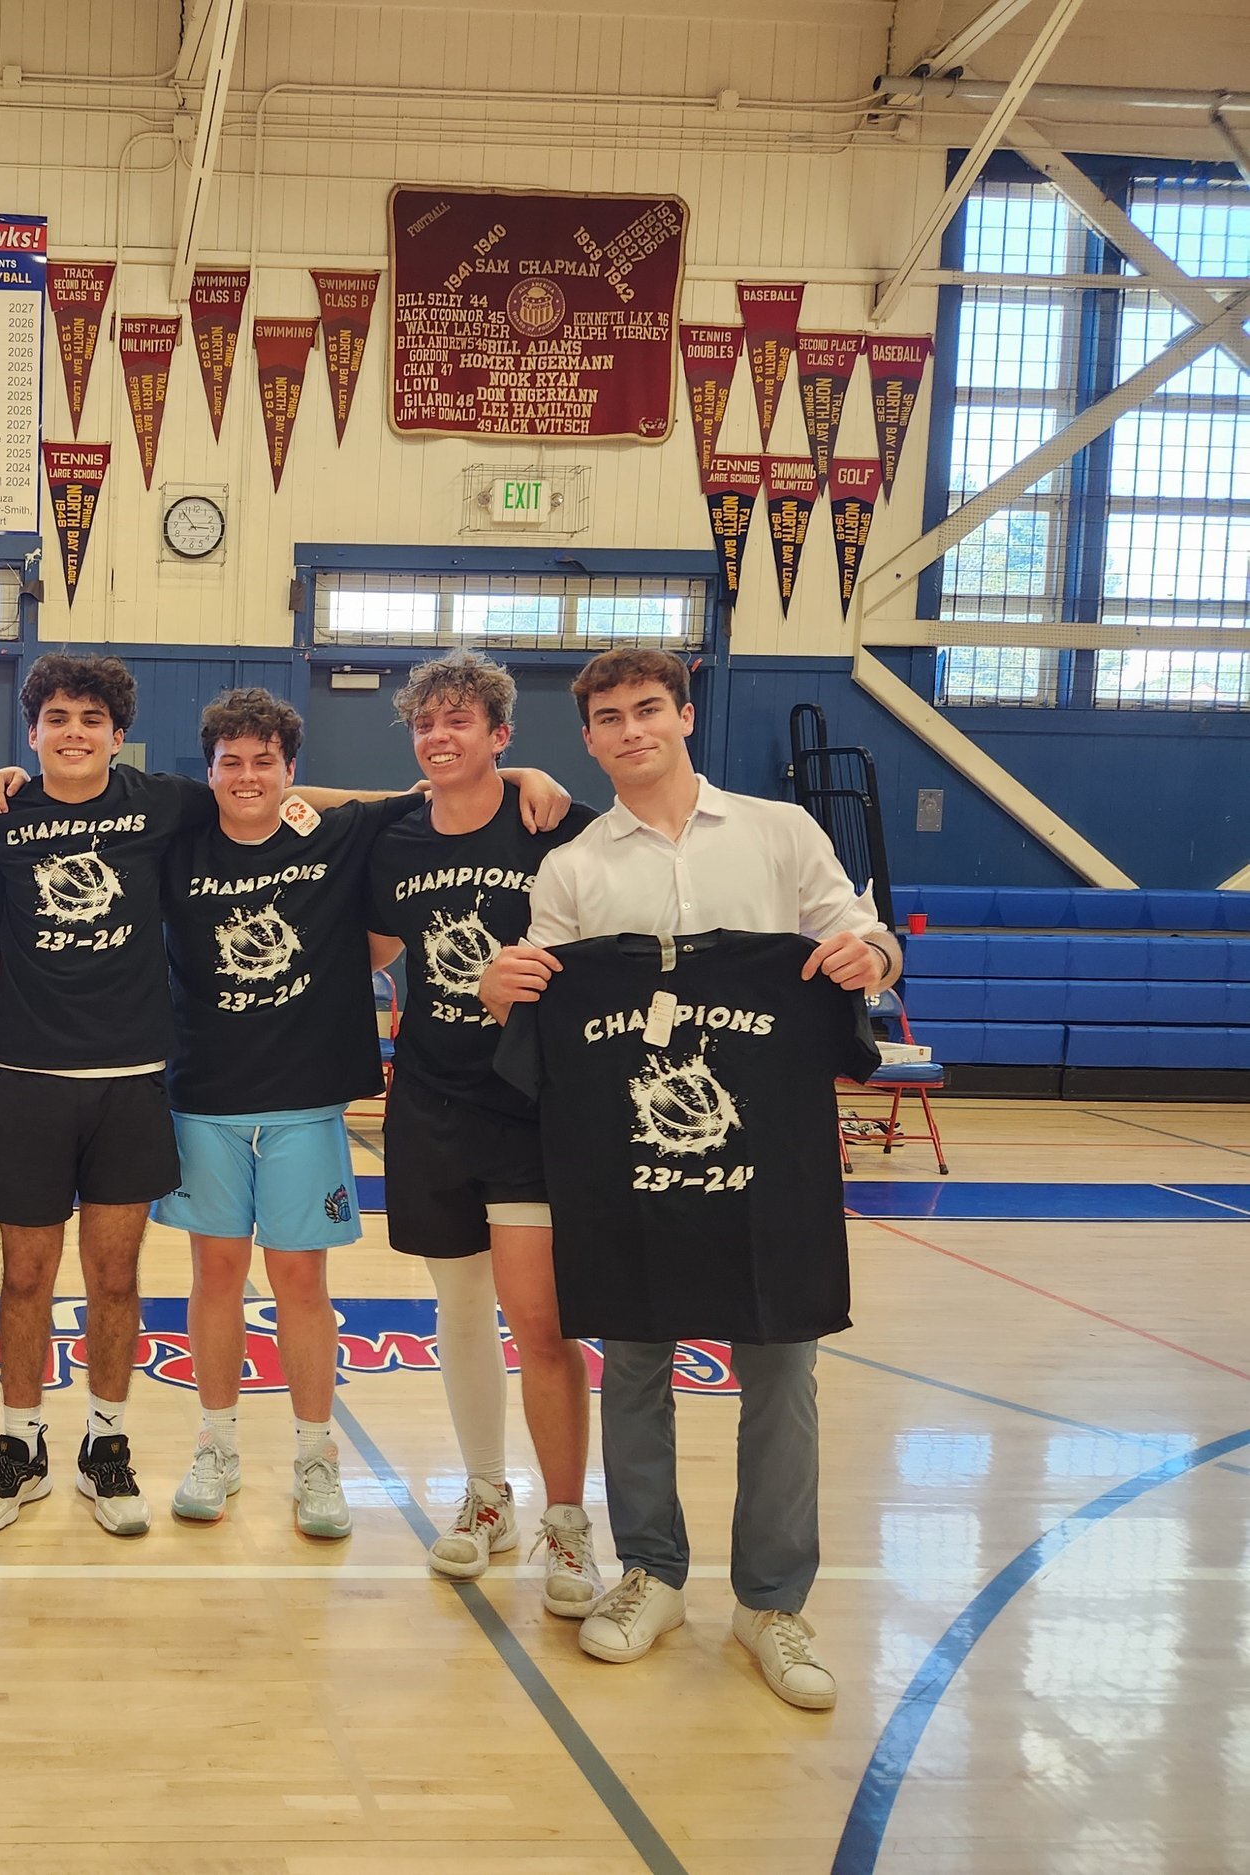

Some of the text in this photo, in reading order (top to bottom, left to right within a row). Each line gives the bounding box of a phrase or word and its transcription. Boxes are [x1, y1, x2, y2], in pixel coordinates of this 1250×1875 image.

[406, 201, 451, 238] FOOTBALL
[653, 202, 681, 236] 1934
[473, 224, 508, 256] 1940
[572, 226, 603, 261] 1939
[63, 268, 94, 279] TRACK
[476, 258, 601, 278] SAM CHAPMAN
[443, 260, 474, 293] 1941
[603, 266, 635, 304] 1942
[397, 294, 424, 308] BILL
[428, 293, 463, 307] SELEY
[744, 291, 797, 301] BASEBALL
[9, 304, 34, 313] 2027
[8, 318, 34, 328] 2026
[8, 333, 33, 342] 2025
[256, 326, 313, 338] SWIMMING
[563, 326, 669, 341] RALPH TIERNEY
[691, 331, 731, 342] TENNIS
[8, 348, 33, 357] 2026
[688, 345, 734, 358] DOUBLES
[8, 362, 33, 371] 2025
[459, 354, 614, 370] HOMER INGERMANN
[489, 372, 580, 387] NOOK RYAN
[482, 402, 592, 418] LEE HAMILTON
[7, 420, 32, 430] 2027
[51, 453, 103, 465] TENNIS
[6, 463, 30, 472] 2024
[838, 468, 874, 485] GOLF
[505, 482, 542, 509] EXIT
[67, 485, 83, 585] NORTH BAY LEAGUE
[843, 503, 860, 599] NORTH BAY LEAGUE
[6, 814, 147, 846] CHAMPIONS
[188, 863, 328, 898] CHAMPIONS
[584, 1004, 776, 1044] CHAPIONS
